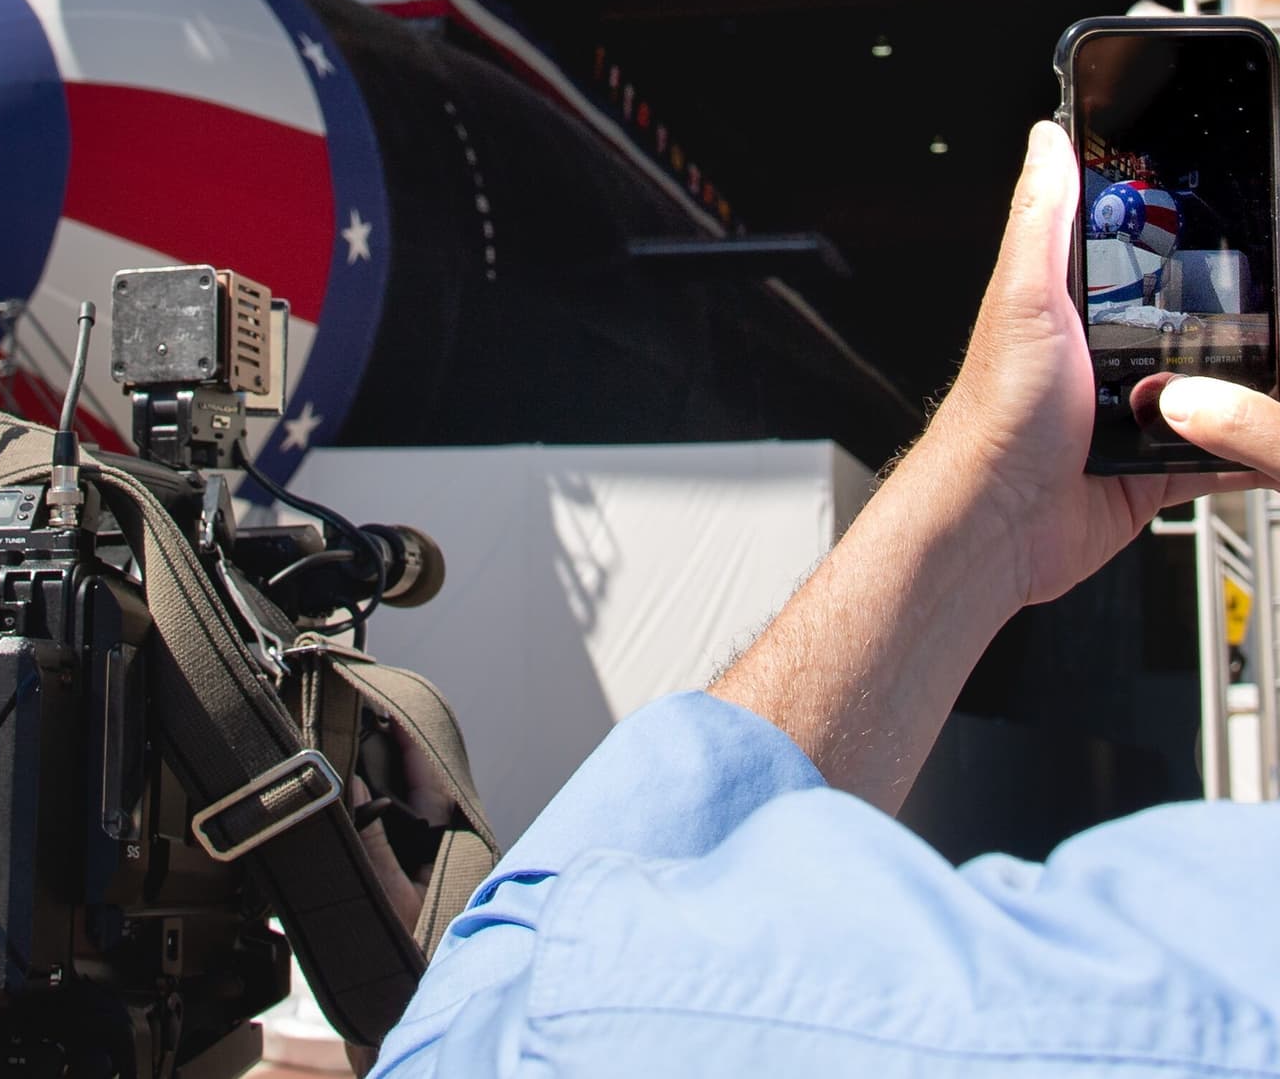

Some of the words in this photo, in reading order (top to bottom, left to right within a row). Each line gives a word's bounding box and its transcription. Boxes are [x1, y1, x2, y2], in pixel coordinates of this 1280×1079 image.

[1129, 357, 1156, 366] VIDEO
[1165, 356, 1194, 365] PHOTO
[1204, 354, 1243, 364] PORTRAIT
